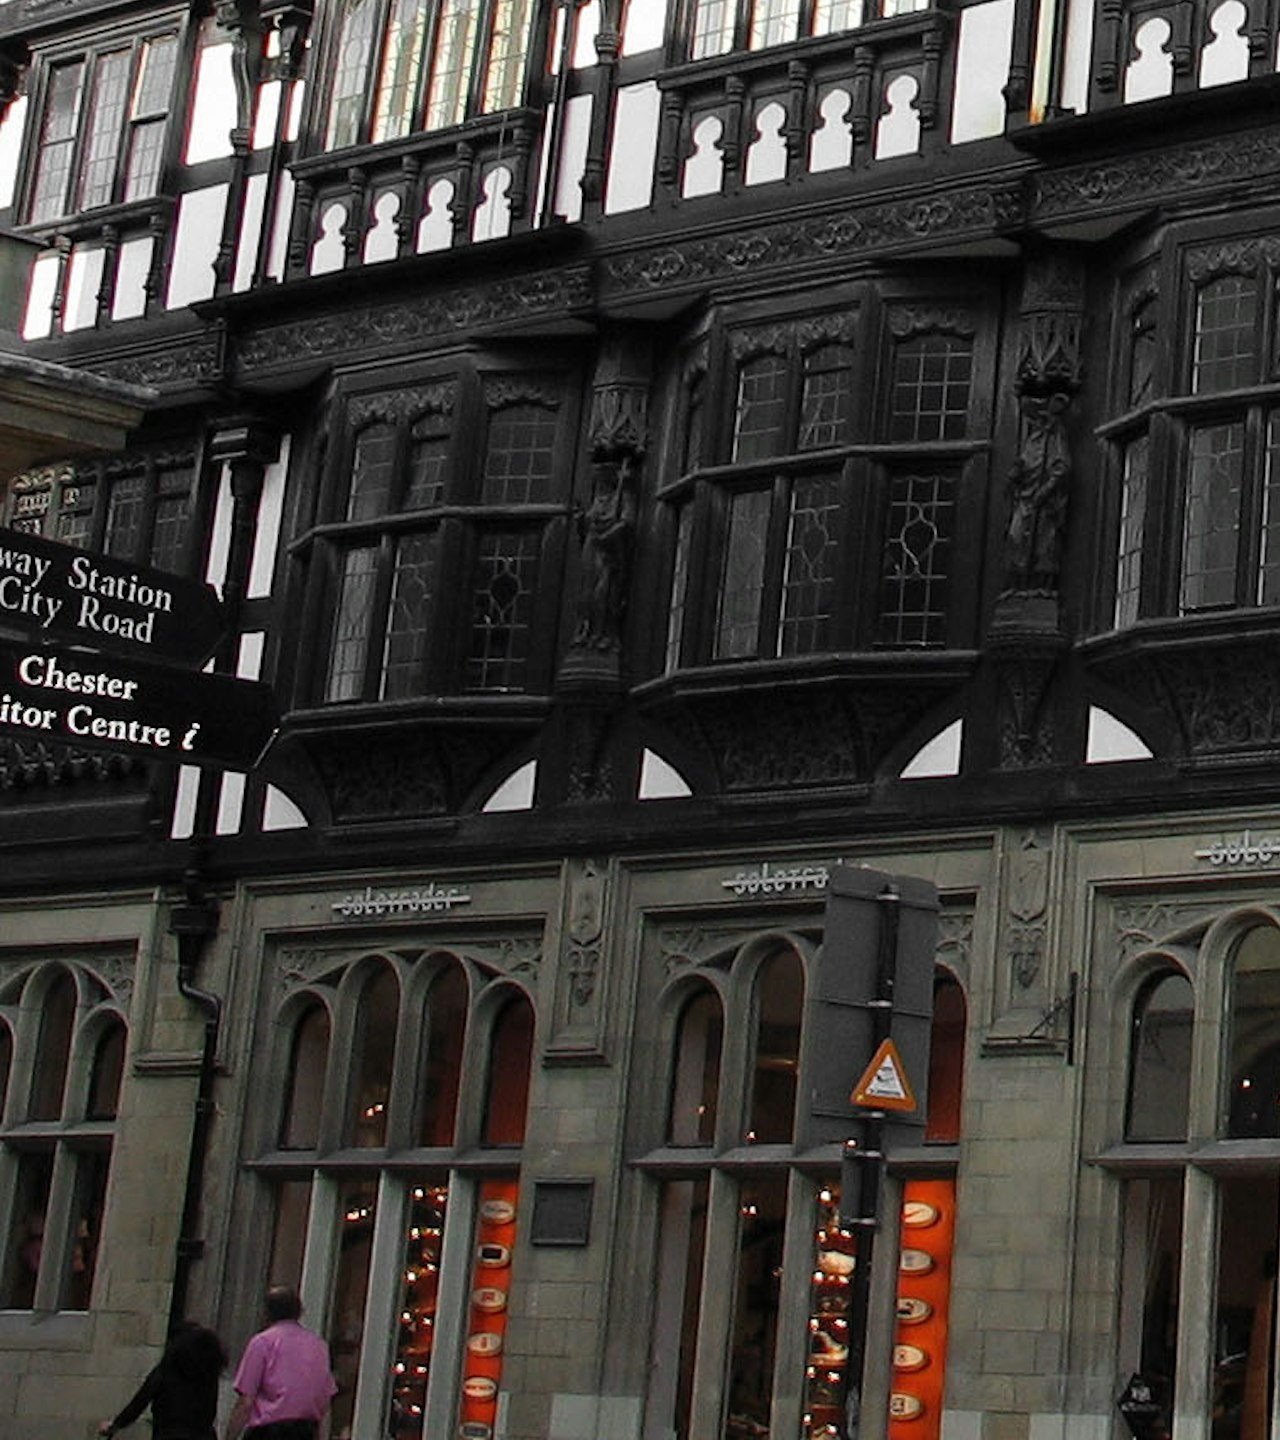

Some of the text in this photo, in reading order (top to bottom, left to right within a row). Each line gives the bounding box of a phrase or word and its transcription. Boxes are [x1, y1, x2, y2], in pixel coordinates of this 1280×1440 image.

[0, 575, 155, 644] City Road
[67, 556, 172, 612] Station
[18, 654, 139, 701] Chester
[66, 704, 171, 747] Centre
